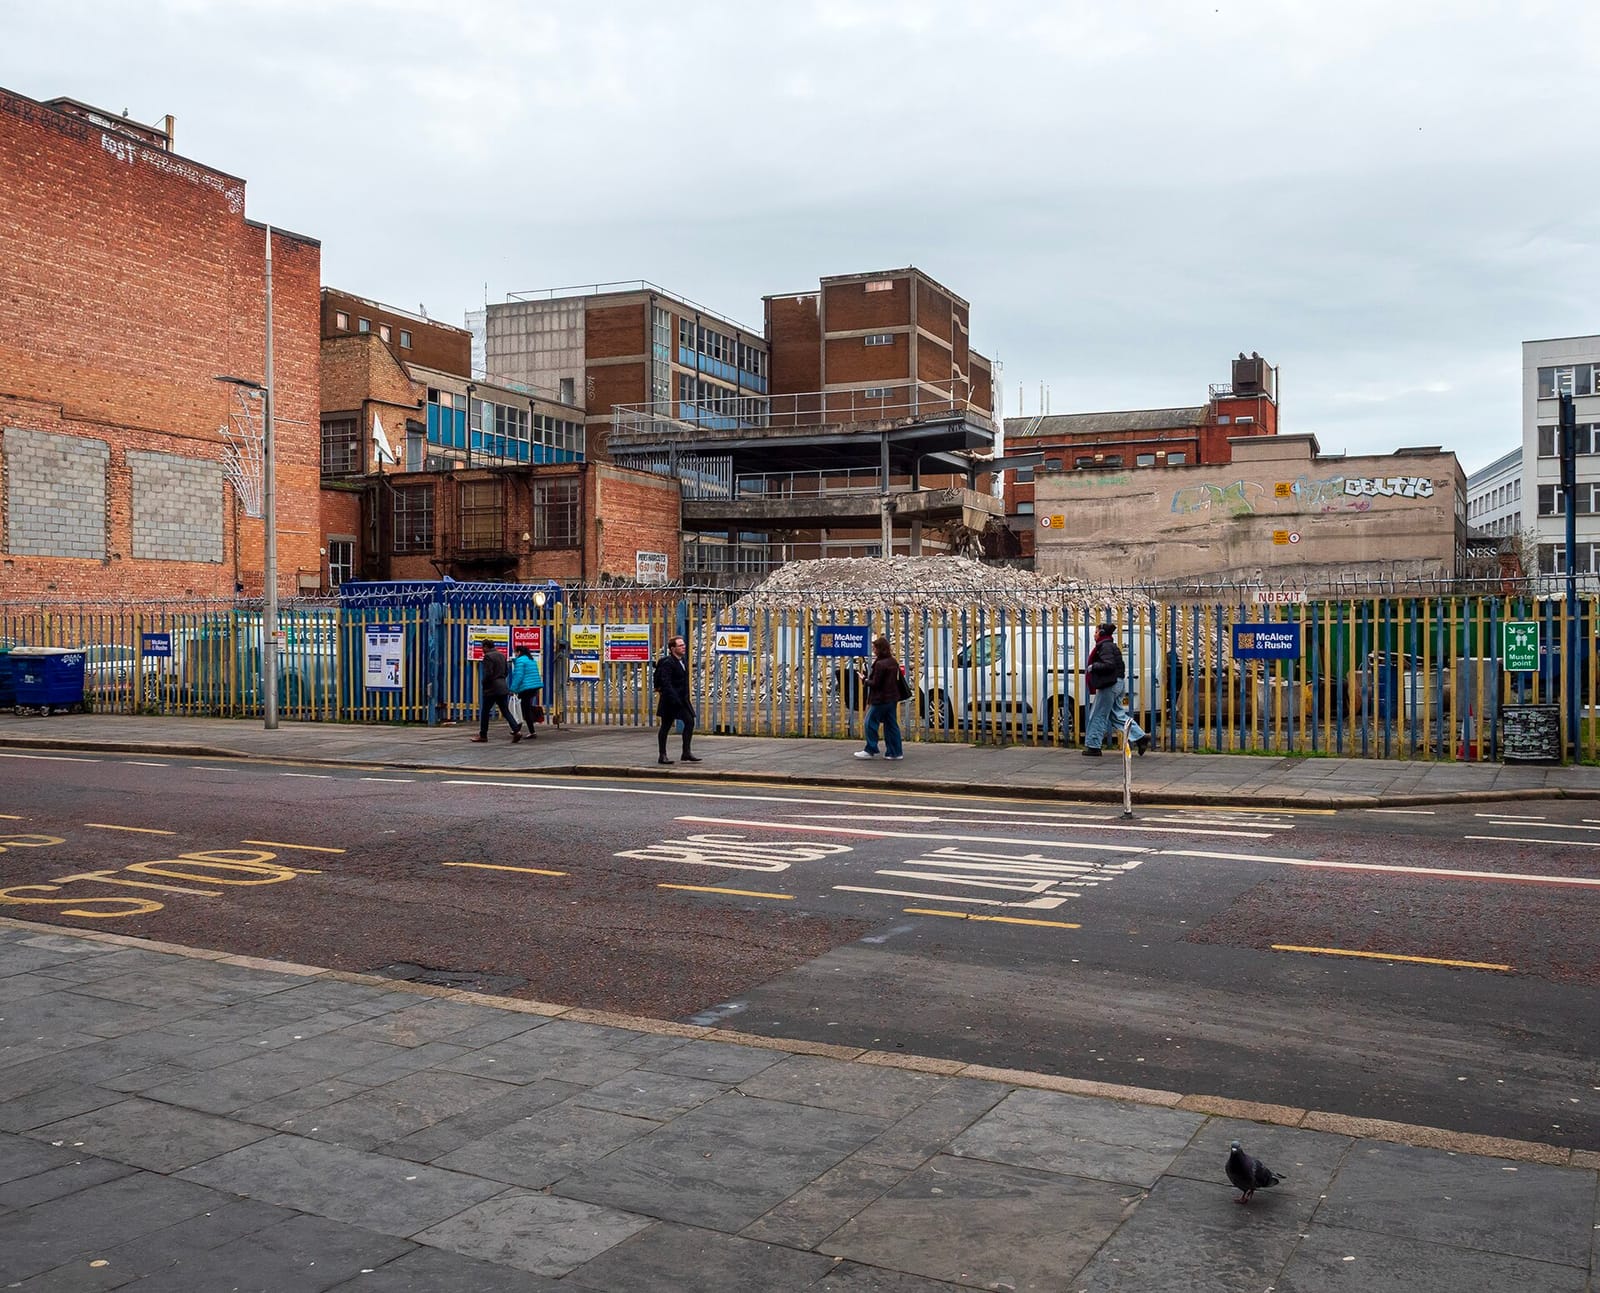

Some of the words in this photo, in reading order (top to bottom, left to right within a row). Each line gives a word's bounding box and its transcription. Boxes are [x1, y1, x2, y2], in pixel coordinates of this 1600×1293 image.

[514, 631, 539, 639] Caution
[834, 633, 863, 641] McAleer
[1256, 633, 1293, 641] McAleer
[1256, 641, 1263, 649] &
[1264, 641, 1292, 649] Rushe
[0, 849, 322, 918] STOP
